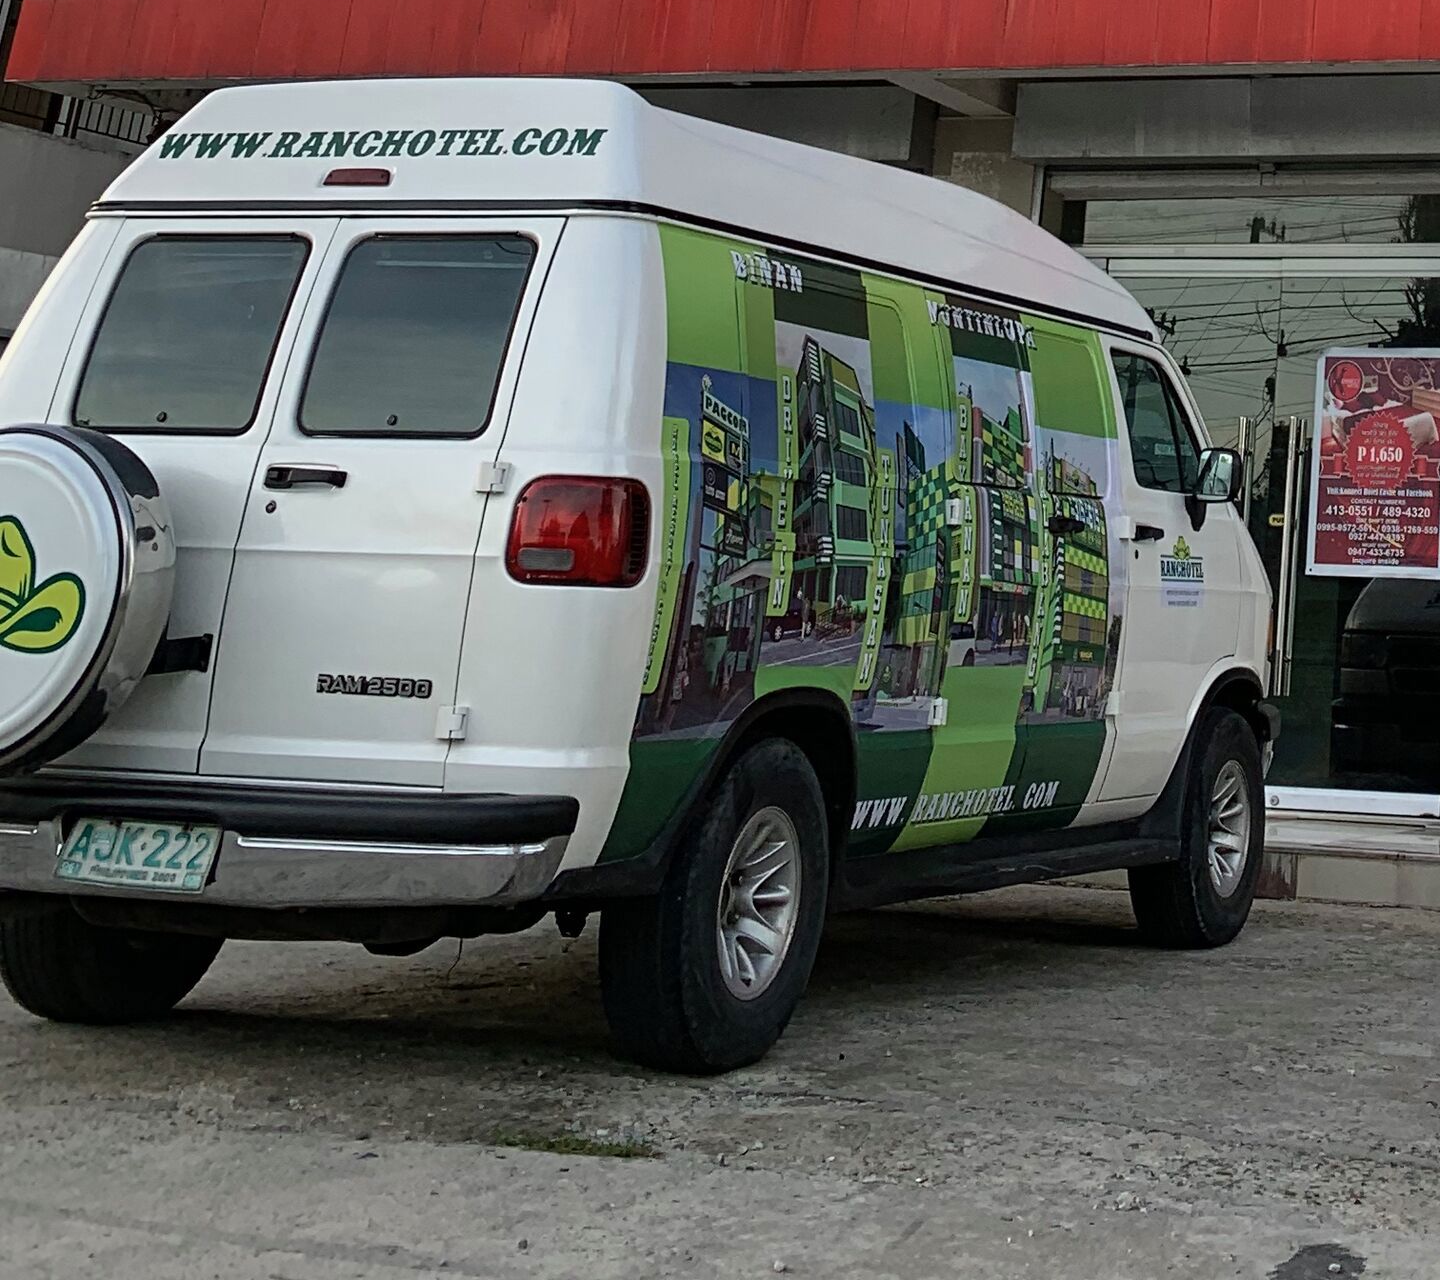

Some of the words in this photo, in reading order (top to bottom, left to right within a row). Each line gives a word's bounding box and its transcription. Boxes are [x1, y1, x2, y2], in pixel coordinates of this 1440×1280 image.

[158, 127, 609, 160] WWW.RANCHOTEL.COM
[777, 375, 794, 529] DRIVE
[1357, 446, 1367, 462] P
[1369, 446, 1404, 464] 1,650
[1406, 488, 1434, 498] Facebook
[1325, 505, 1373, 516] 413-0551
[1382, 507, 1431, 518] 489-4320
[859, 454, 891, 685] TUNASAN
[1160, 560, 1204, 578] RANCHOTEL
[316, 674, 367, 694] RAM
[366, 676, 433, 699] 2500
